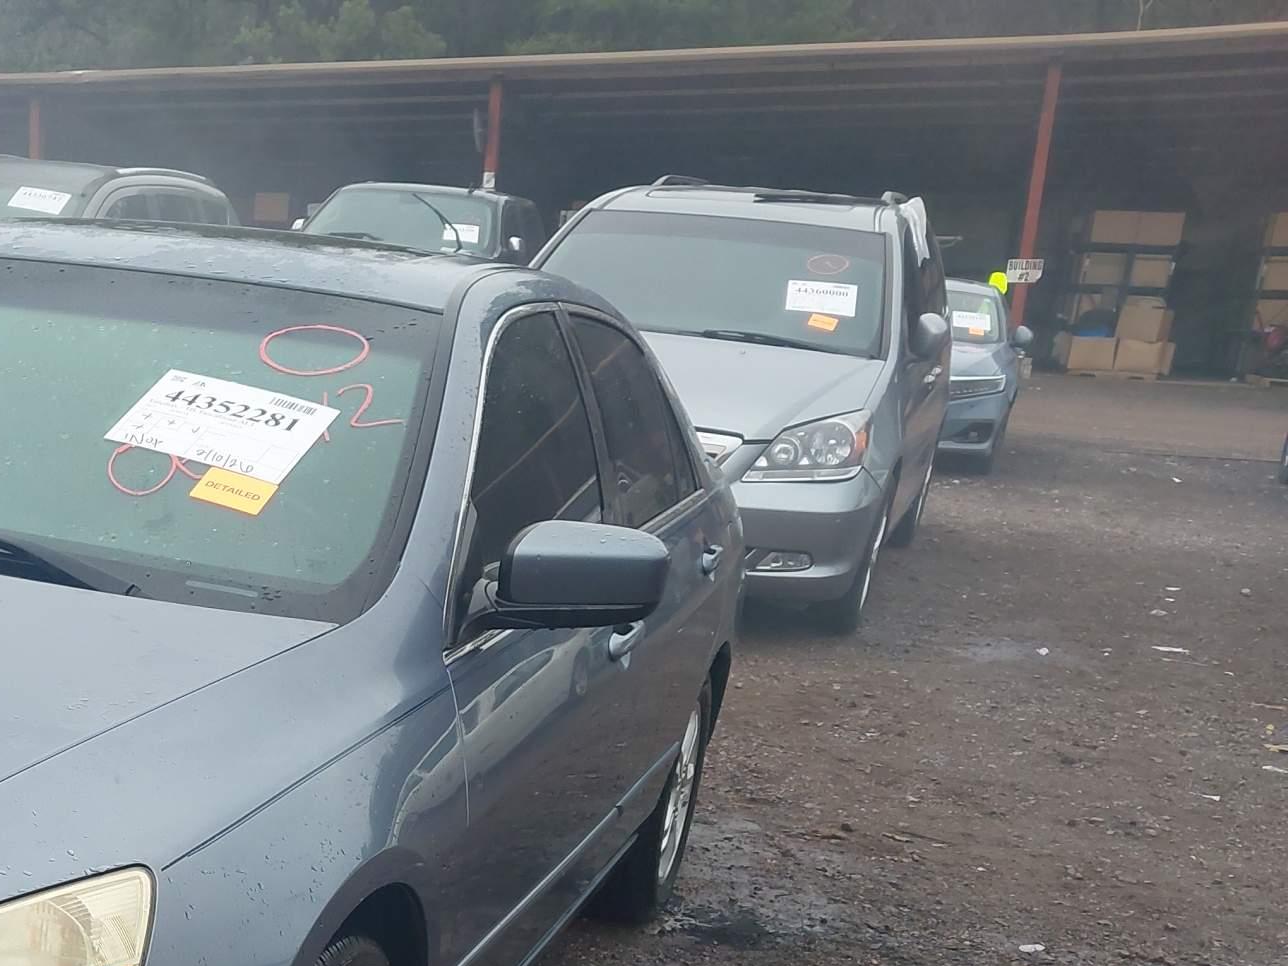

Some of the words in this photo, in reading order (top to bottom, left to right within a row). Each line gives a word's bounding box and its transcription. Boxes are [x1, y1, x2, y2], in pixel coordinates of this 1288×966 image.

[1008, 260, 1043, 271] BUILDING
[1017, 272, 1030, 282] #2
[165, 390, 300, 432] 44352281
[205, 480, 261, 501] DETAILED
